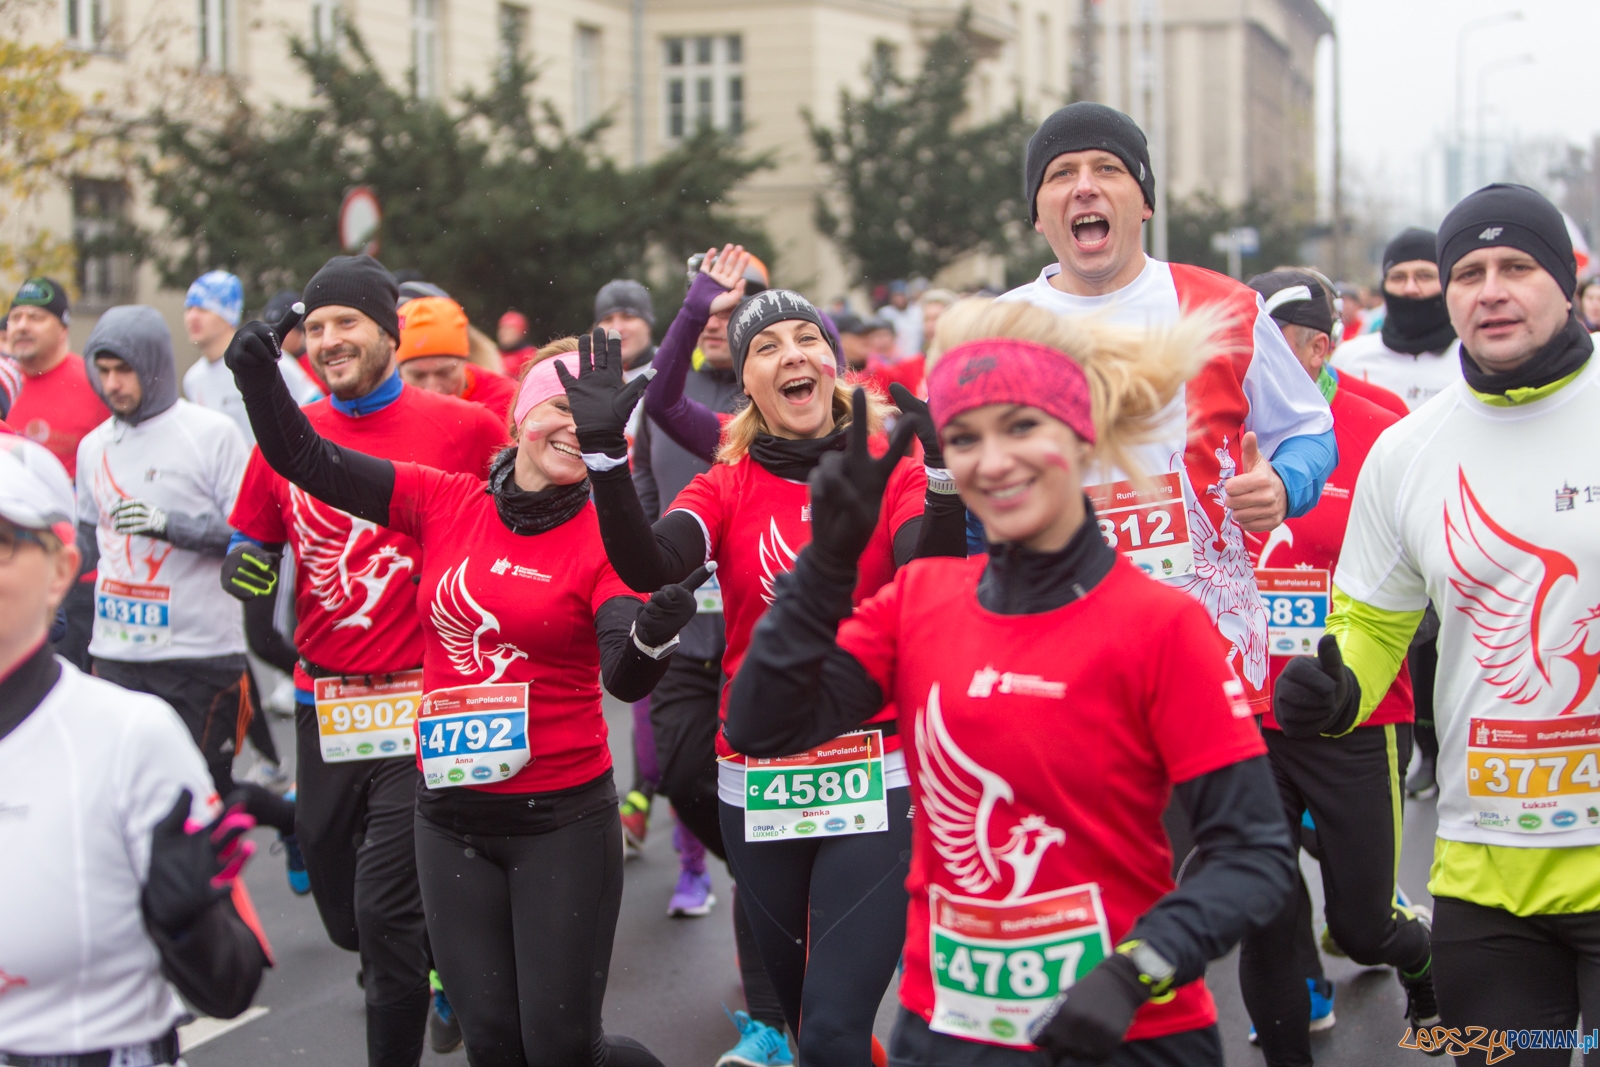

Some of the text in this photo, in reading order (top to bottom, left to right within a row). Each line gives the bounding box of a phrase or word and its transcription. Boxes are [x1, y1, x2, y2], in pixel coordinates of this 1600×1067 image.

[1478, 227, 1503, 240] 4F
[1584, 485, 1593, 502] 1
[1274, 579, 1321, 588] RunPoland.org
[104, 598, 160, 625] 9318
[374, 680, 418, 691] RunPoland.org
[465, 695, 518, 705] RunPoland.org
[331, 699, 414, 732] 9902
[421, 717, 513, 753] E 4792
[817, 744, 872, 758] RunPoland.org
[455, 757, 474, 765] Anna
[1470, 753, 1600, 794] D 3774
[749, 768, 869, 805] C 4580
[1522, 801, 1558, 809] Łukasz
[802, 809, 830, 818] Danka
[948, 941, 1085, 997] 4787
